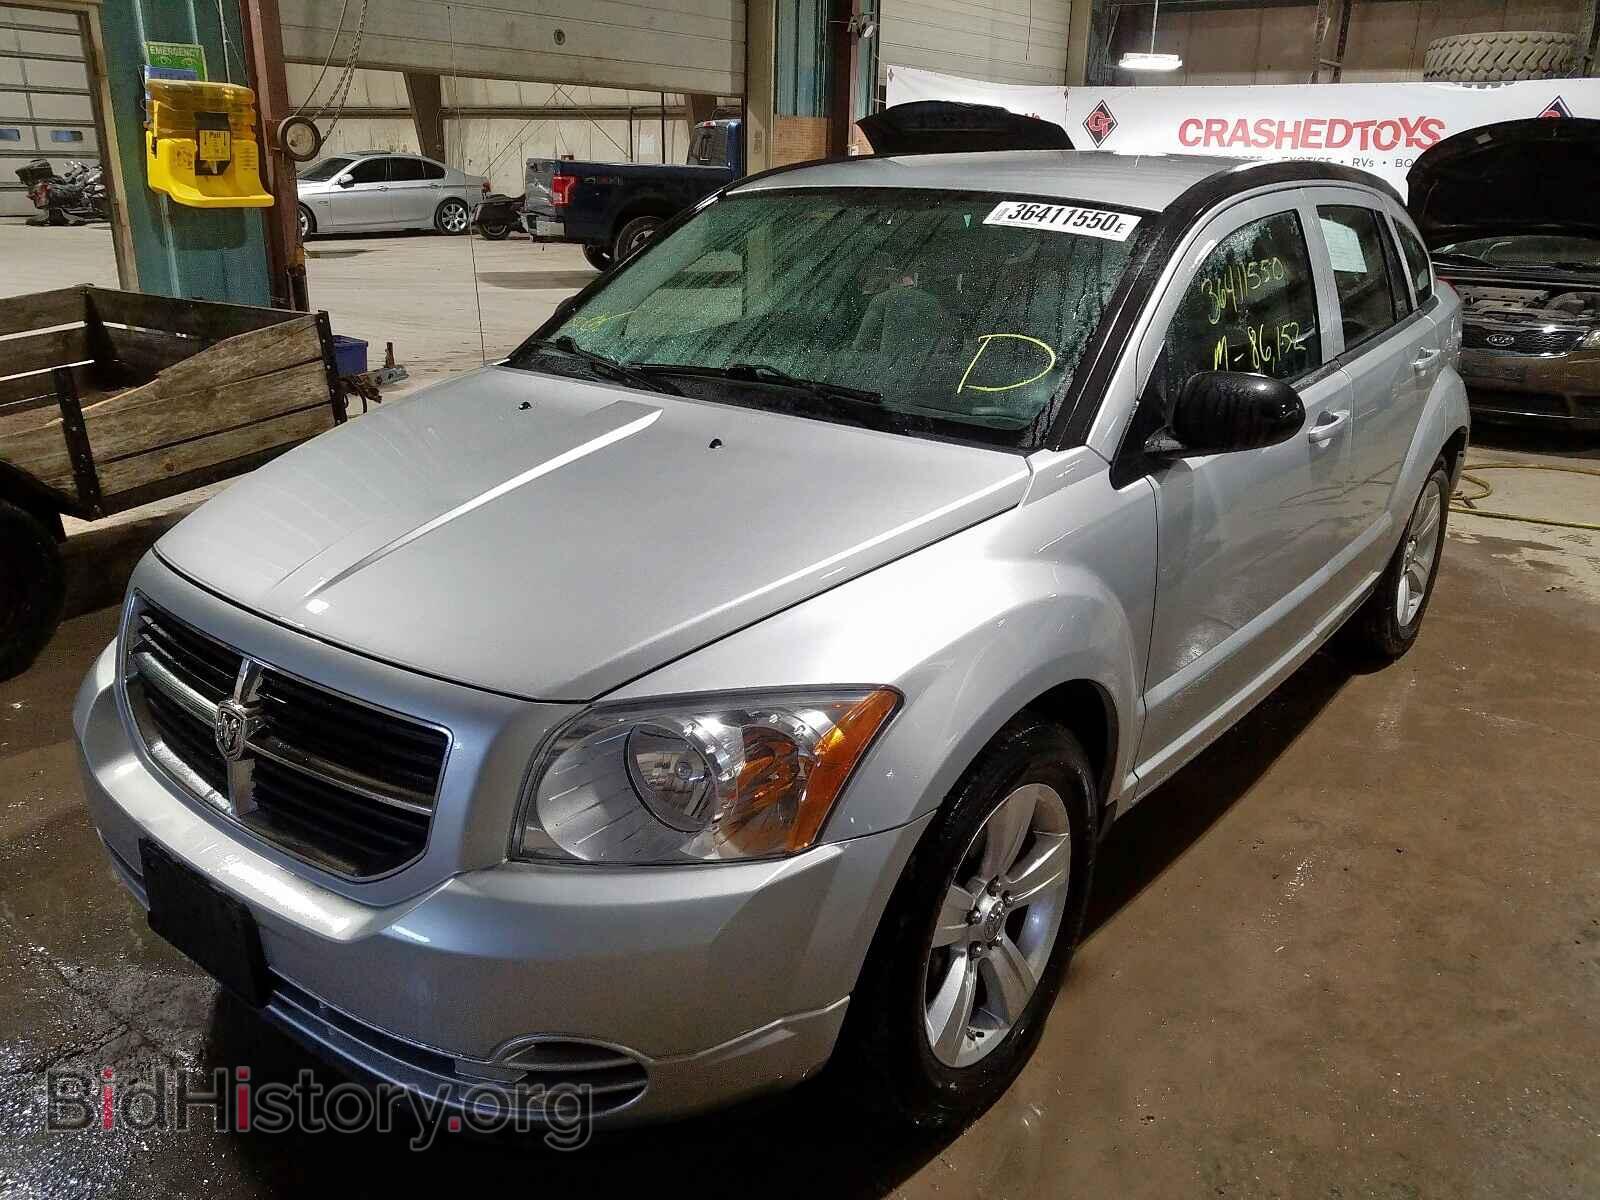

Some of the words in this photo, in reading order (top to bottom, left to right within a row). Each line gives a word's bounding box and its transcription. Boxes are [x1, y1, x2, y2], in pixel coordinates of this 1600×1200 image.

[150, 46, 200, 57] EMERGENCY
[1178, 115, 1446, 151] CRASHEDTOYS
[1352, 157, 1375, 167] RVs
[956, 333, 1056, 394] D
